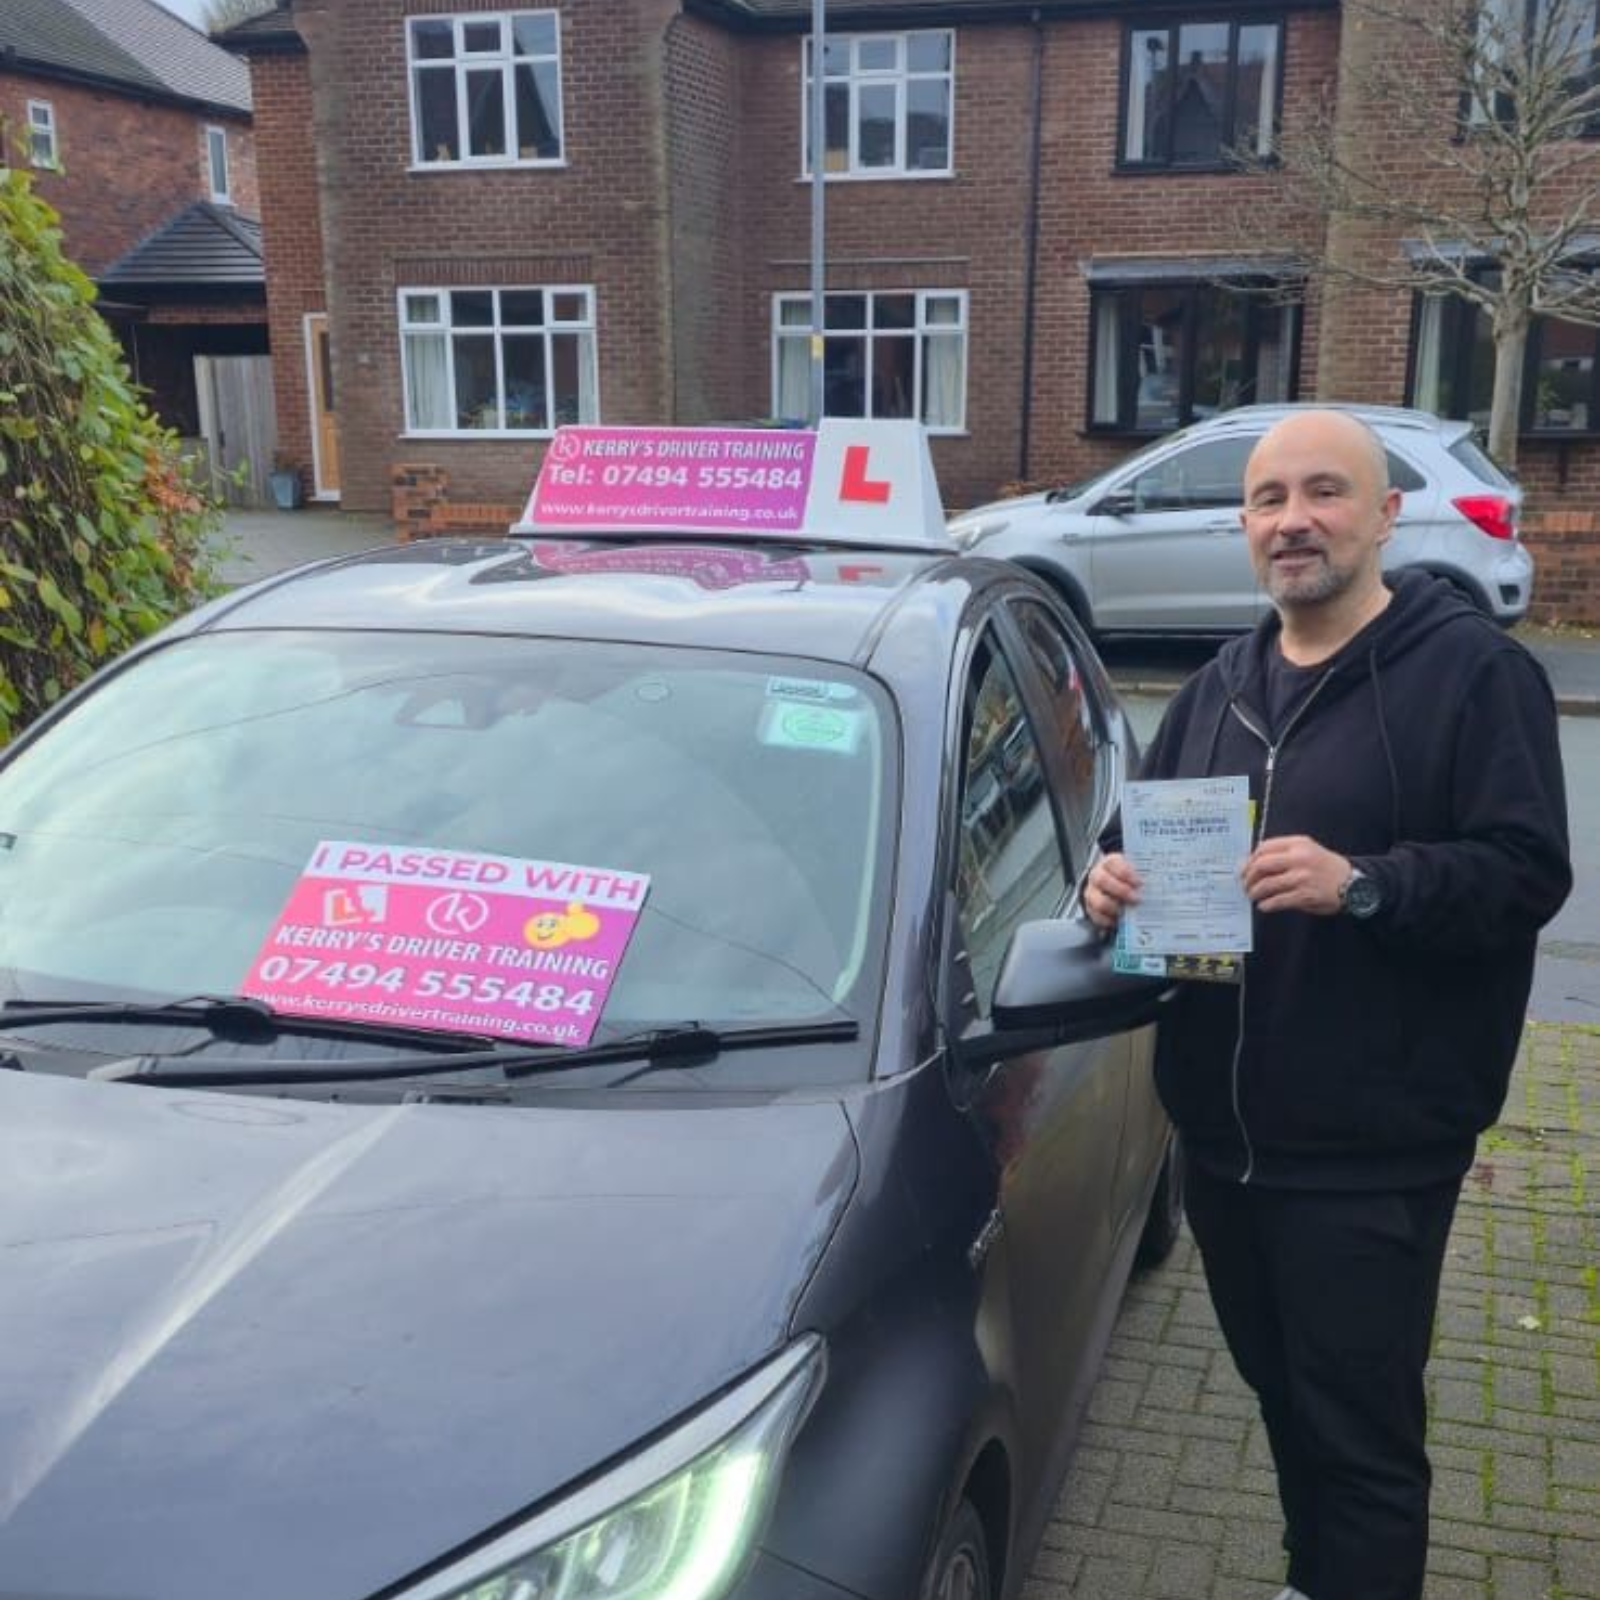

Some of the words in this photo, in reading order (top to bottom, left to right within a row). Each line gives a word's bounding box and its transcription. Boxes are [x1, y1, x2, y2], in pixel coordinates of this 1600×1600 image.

[583, 439, 654, 458] KERRY'S
[657, 441, 719, 459] DRIVER
[724, 442, 804, 460] TRAINING
[839, 446, 891, 504] L
[549, 465, 593, 486] Tel:
[602, 467, 688, 487] 07494
[698, 468, 803, 489] 555484
[541, 502, 798, 521] www.kerrysdrivertraining.co.uk
[315, 848, 328, 869] I
[338, 850, 510, 885] PASSED
[525, 867, 641, 902] WITH
[275, 925, 384, 953] KERRY'S
[387, 937, 482, 963] DRIVER
[486, 947, 609, 979] TRAINING
[259, 956, 406, 995] 07494
[415, 970, 594, 1015] 555484
